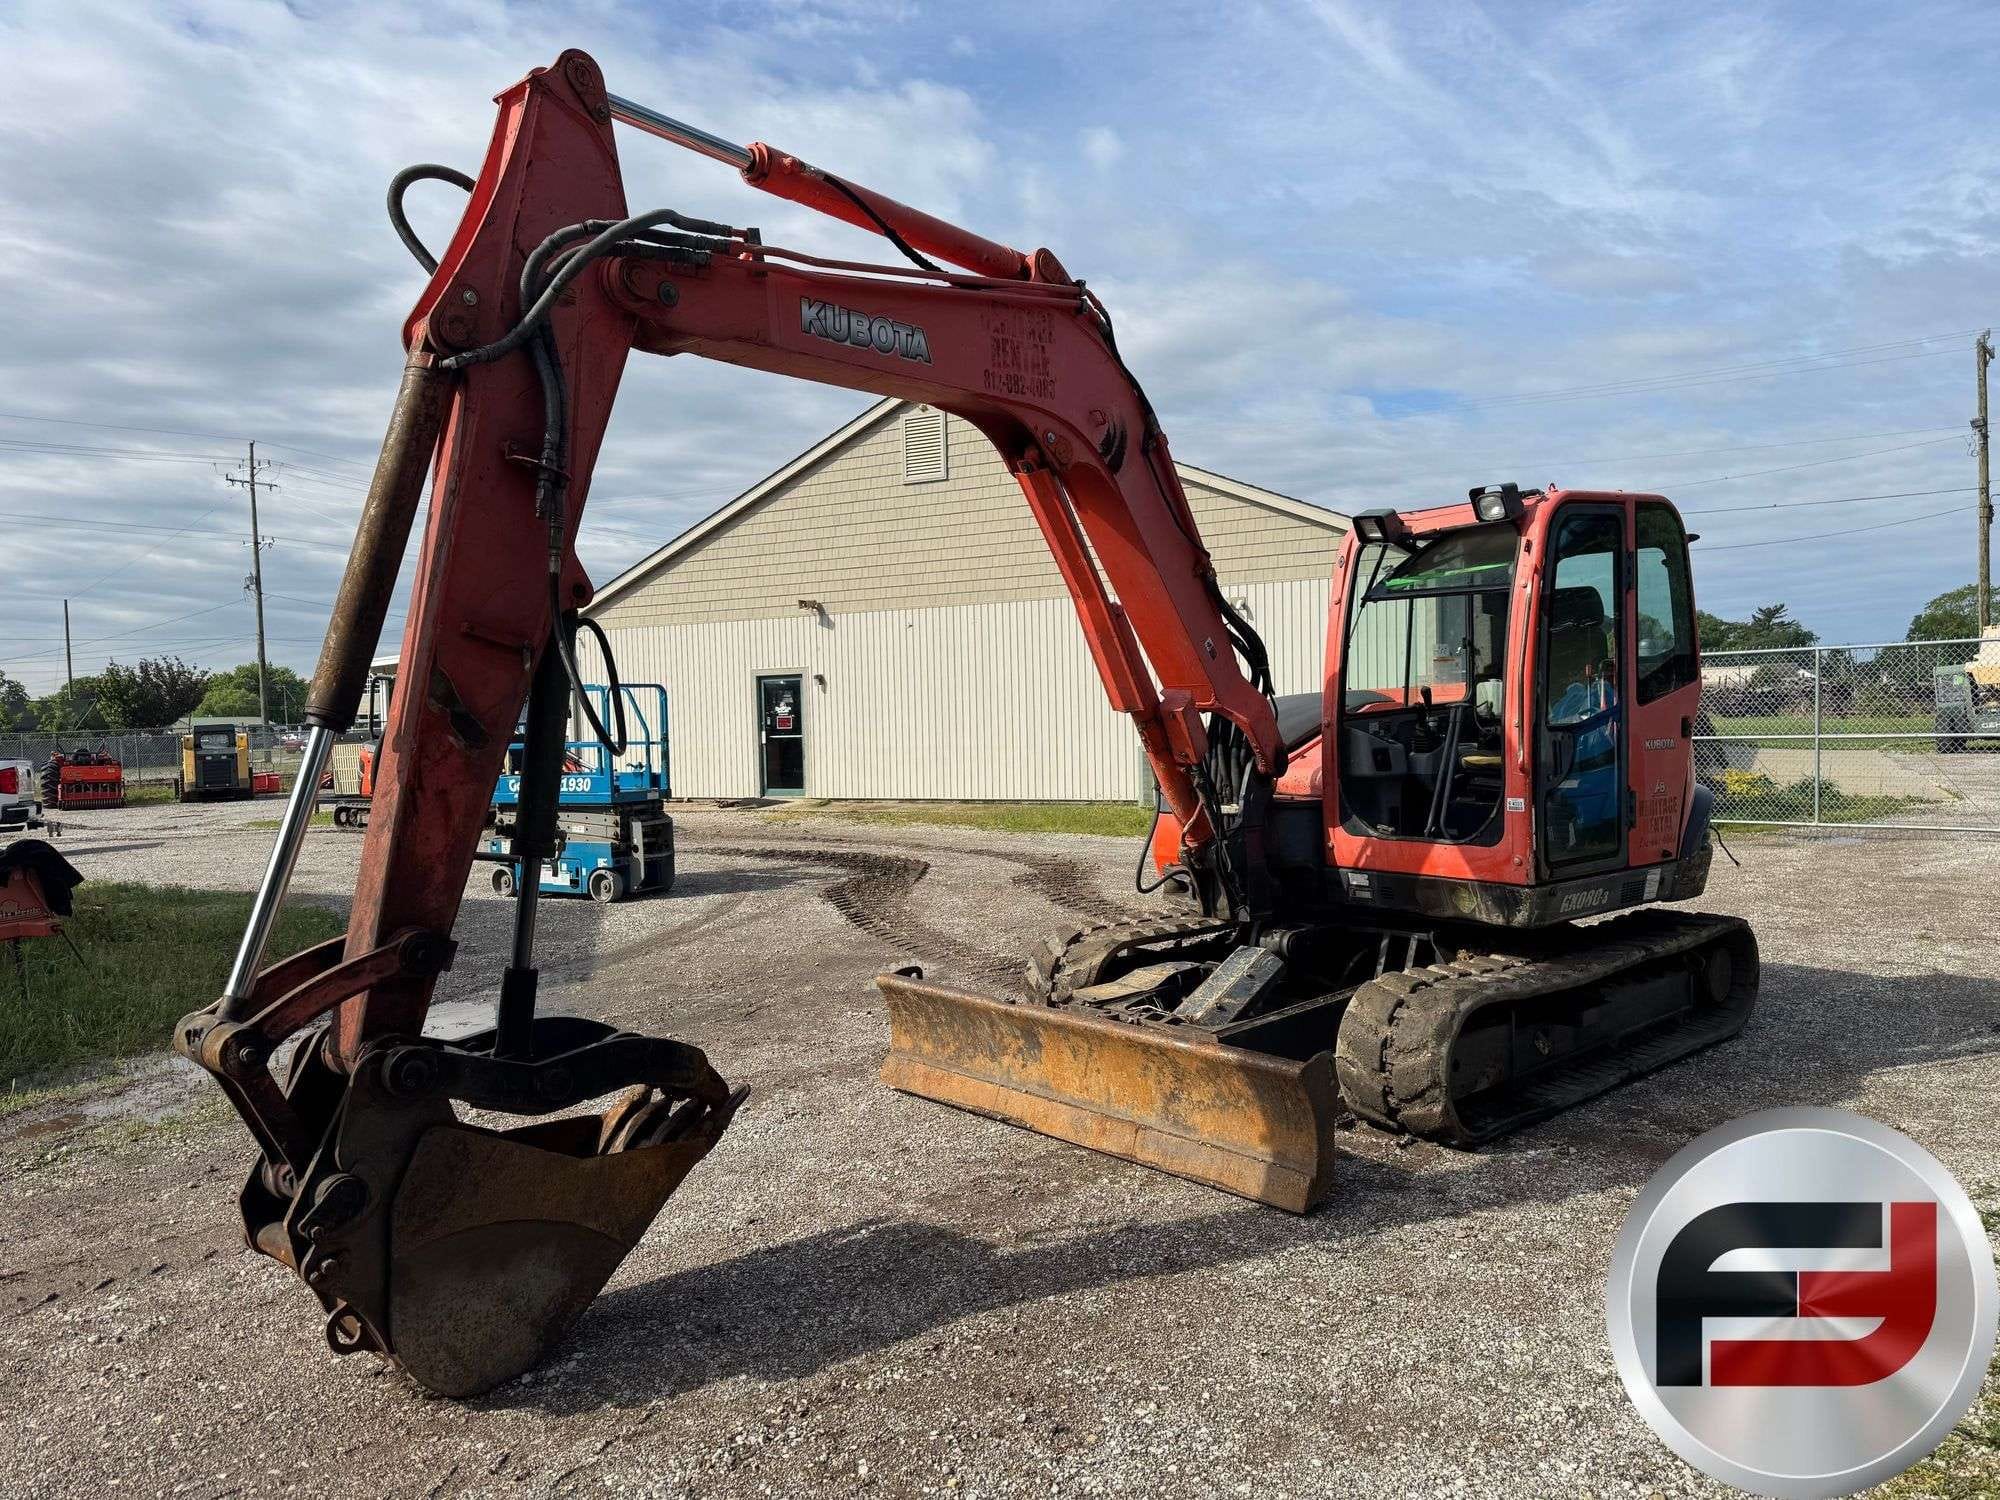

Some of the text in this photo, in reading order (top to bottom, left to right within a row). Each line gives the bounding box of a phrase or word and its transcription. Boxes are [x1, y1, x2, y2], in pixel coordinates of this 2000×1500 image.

[800, 297, 932, 365] KUBOTA
[1645, 739, 1676, 750] KUBOTA
[560, 777, 592, 791] 1930
